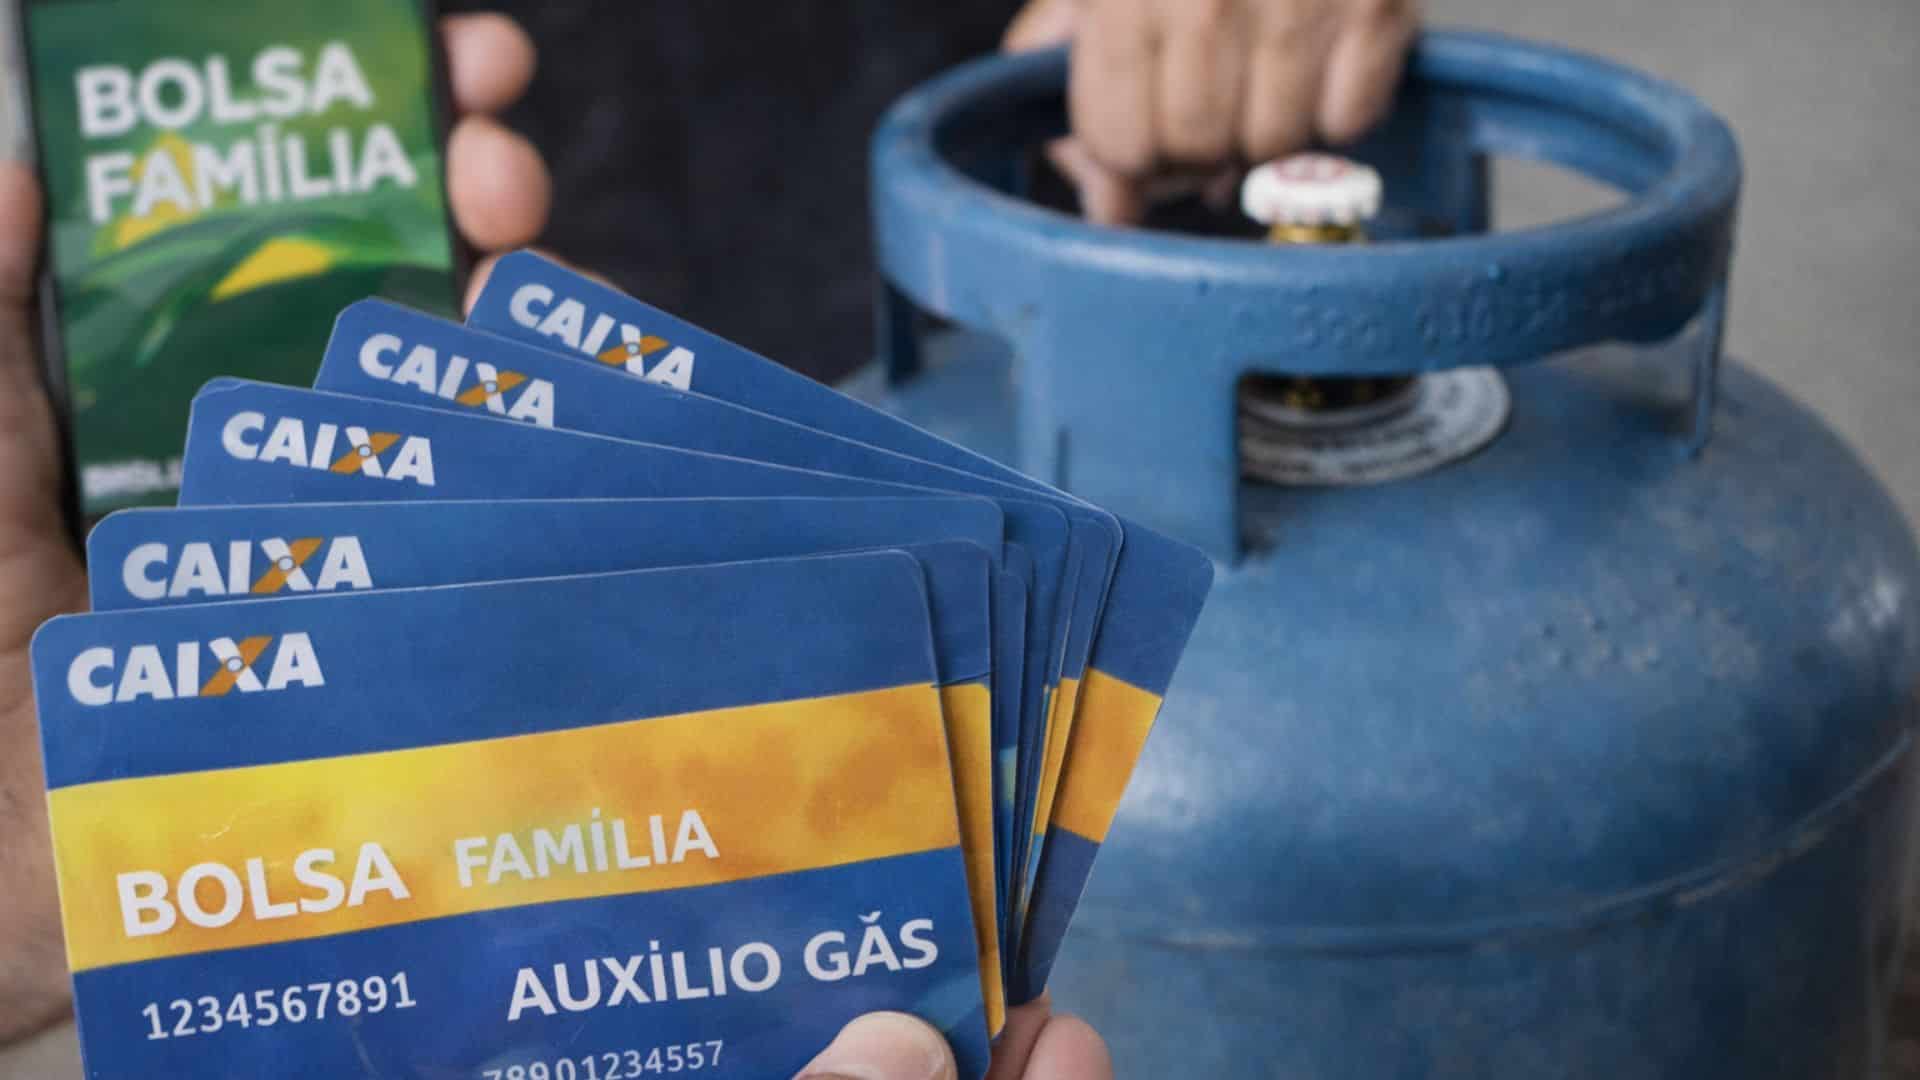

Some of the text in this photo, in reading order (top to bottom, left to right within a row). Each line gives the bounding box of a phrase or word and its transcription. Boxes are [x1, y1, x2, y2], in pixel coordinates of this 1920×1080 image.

[76, 42, 374, 139] BOLSA
[509, 283, 695, 391] CAIXA
[359, 333, 555, 428] CAIXA
[222, 412, 436, 486] CAIXA
[122, 536, 373, 599] CAIXA
[67, 632, 326, 705] CAIXA
[116, 842, 411, 937] BOLSA
[143, 971, 417, 1039] 1234567891
